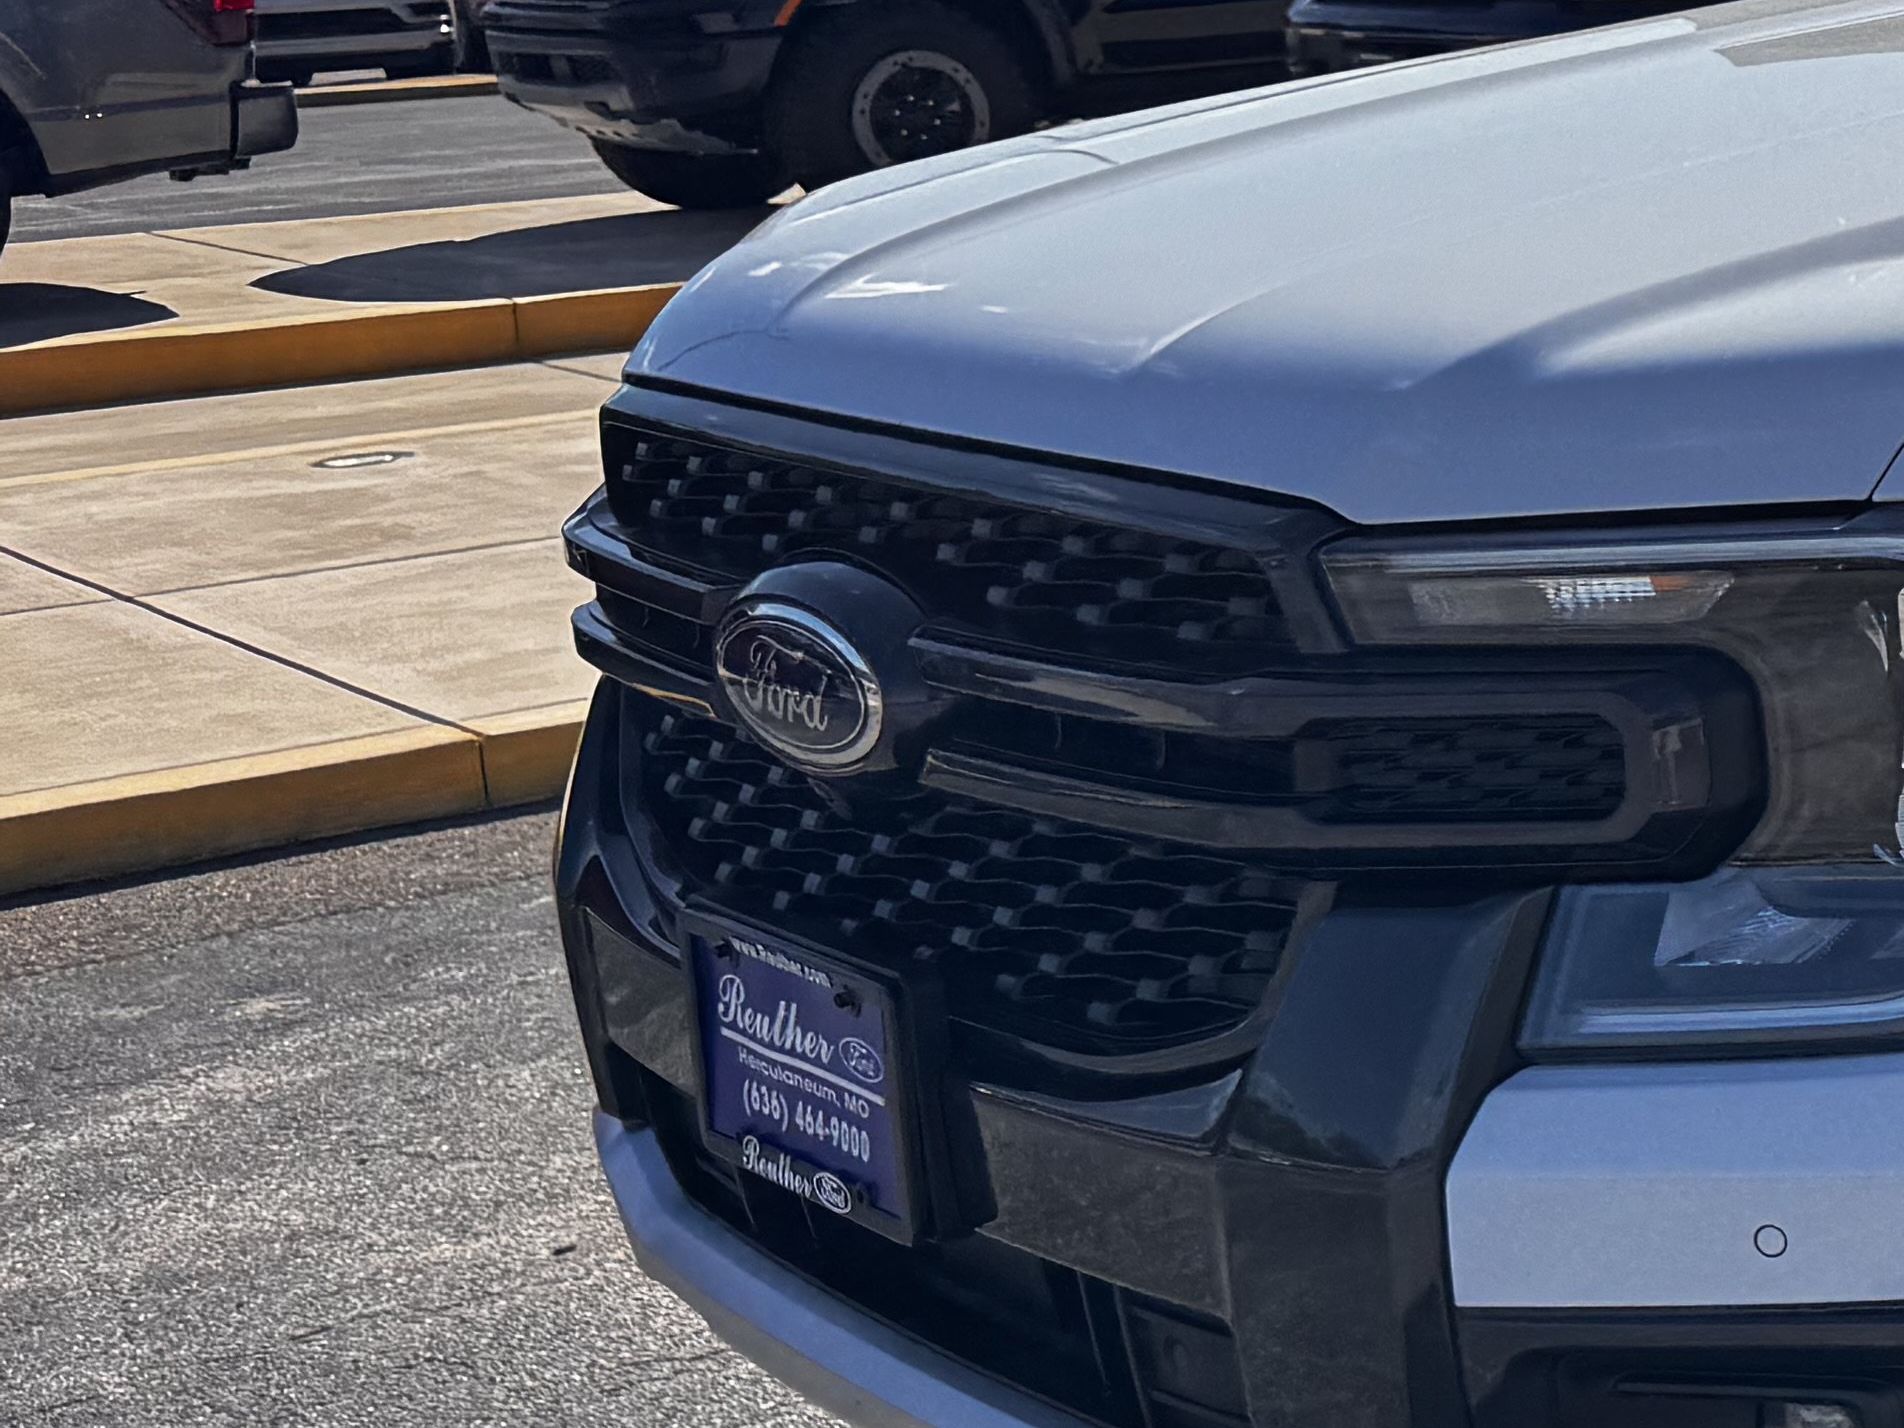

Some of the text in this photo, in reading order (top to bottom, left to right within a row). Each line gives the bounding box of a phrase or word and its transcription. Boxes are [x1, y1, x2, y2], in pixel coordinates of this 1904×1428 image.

[744, 634, 832, 732] Ford
[717, 974, 834, 1065] Reuther
[737, 1046, 870, 1119] Herculaneum, MO
[743, 1078, 870, 1163] (636) 464-9000
[742, 1134, 814, 1199] Reuther
